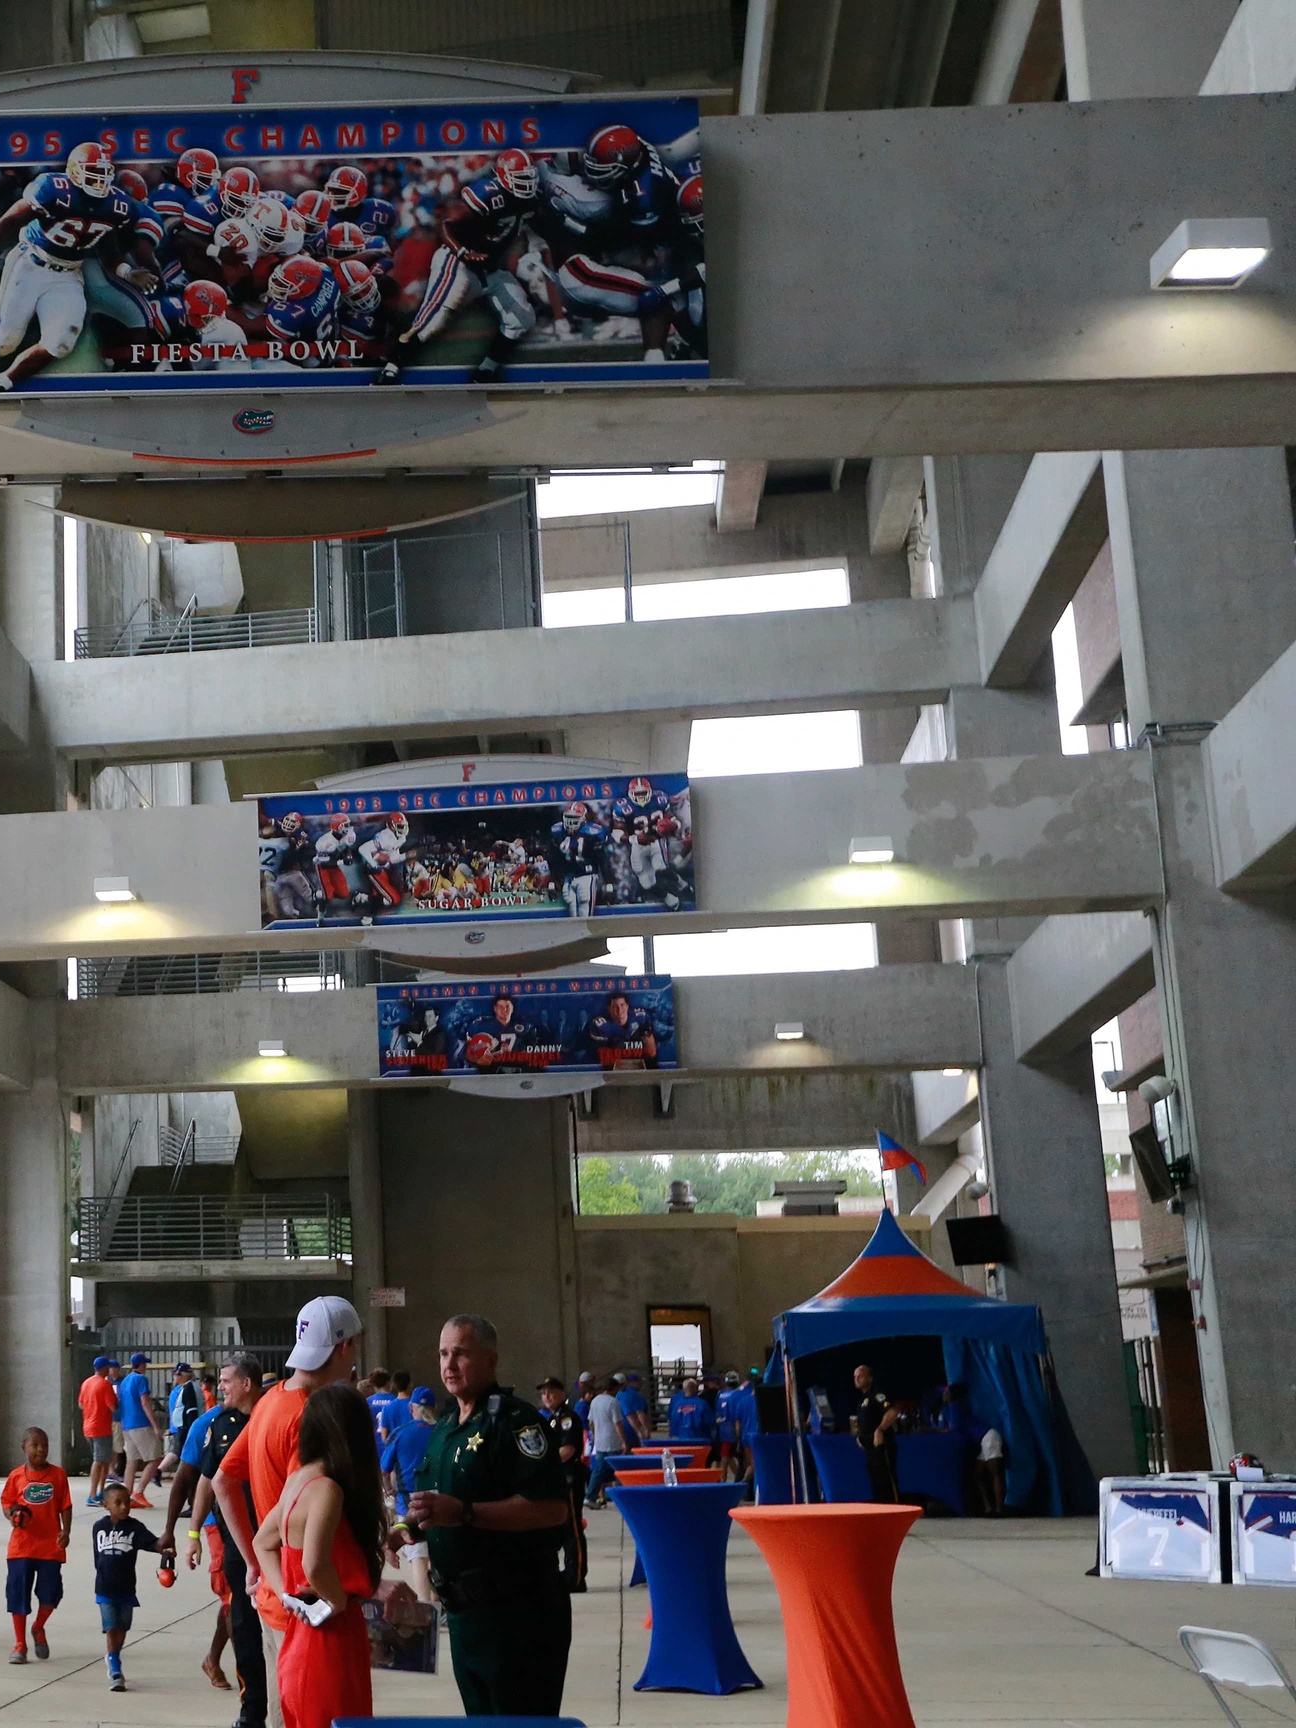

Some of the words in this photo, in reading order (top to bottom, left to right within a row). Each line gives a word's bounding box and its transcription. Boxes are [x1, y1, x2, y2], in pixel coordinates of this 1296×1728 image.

[232, 69, 258, 103] F
[100, 128, 189, 155] SEC
[224, 117, 540, 151] CHAMPIONS
[47, 219, 114, 250] 67
[131, 342, 249, 364] FIESTA
[266, 339, 364, 360] BOWL
[325, 797, 383, 812] 1993
[398, 791, 442, 809] SEC
[458, 783, 613, 806] CHAMPIONS
[417, 896, 473, 911] SUGAR
[480, 894, 529, 908] BOWL
[385, 1049, 417, 1058] STEVE
[526, 1043, 563, 1054] DANNY
[623, 1040, 644, 1050] TIM
[1146, 1526, 1170, 1567] 7
